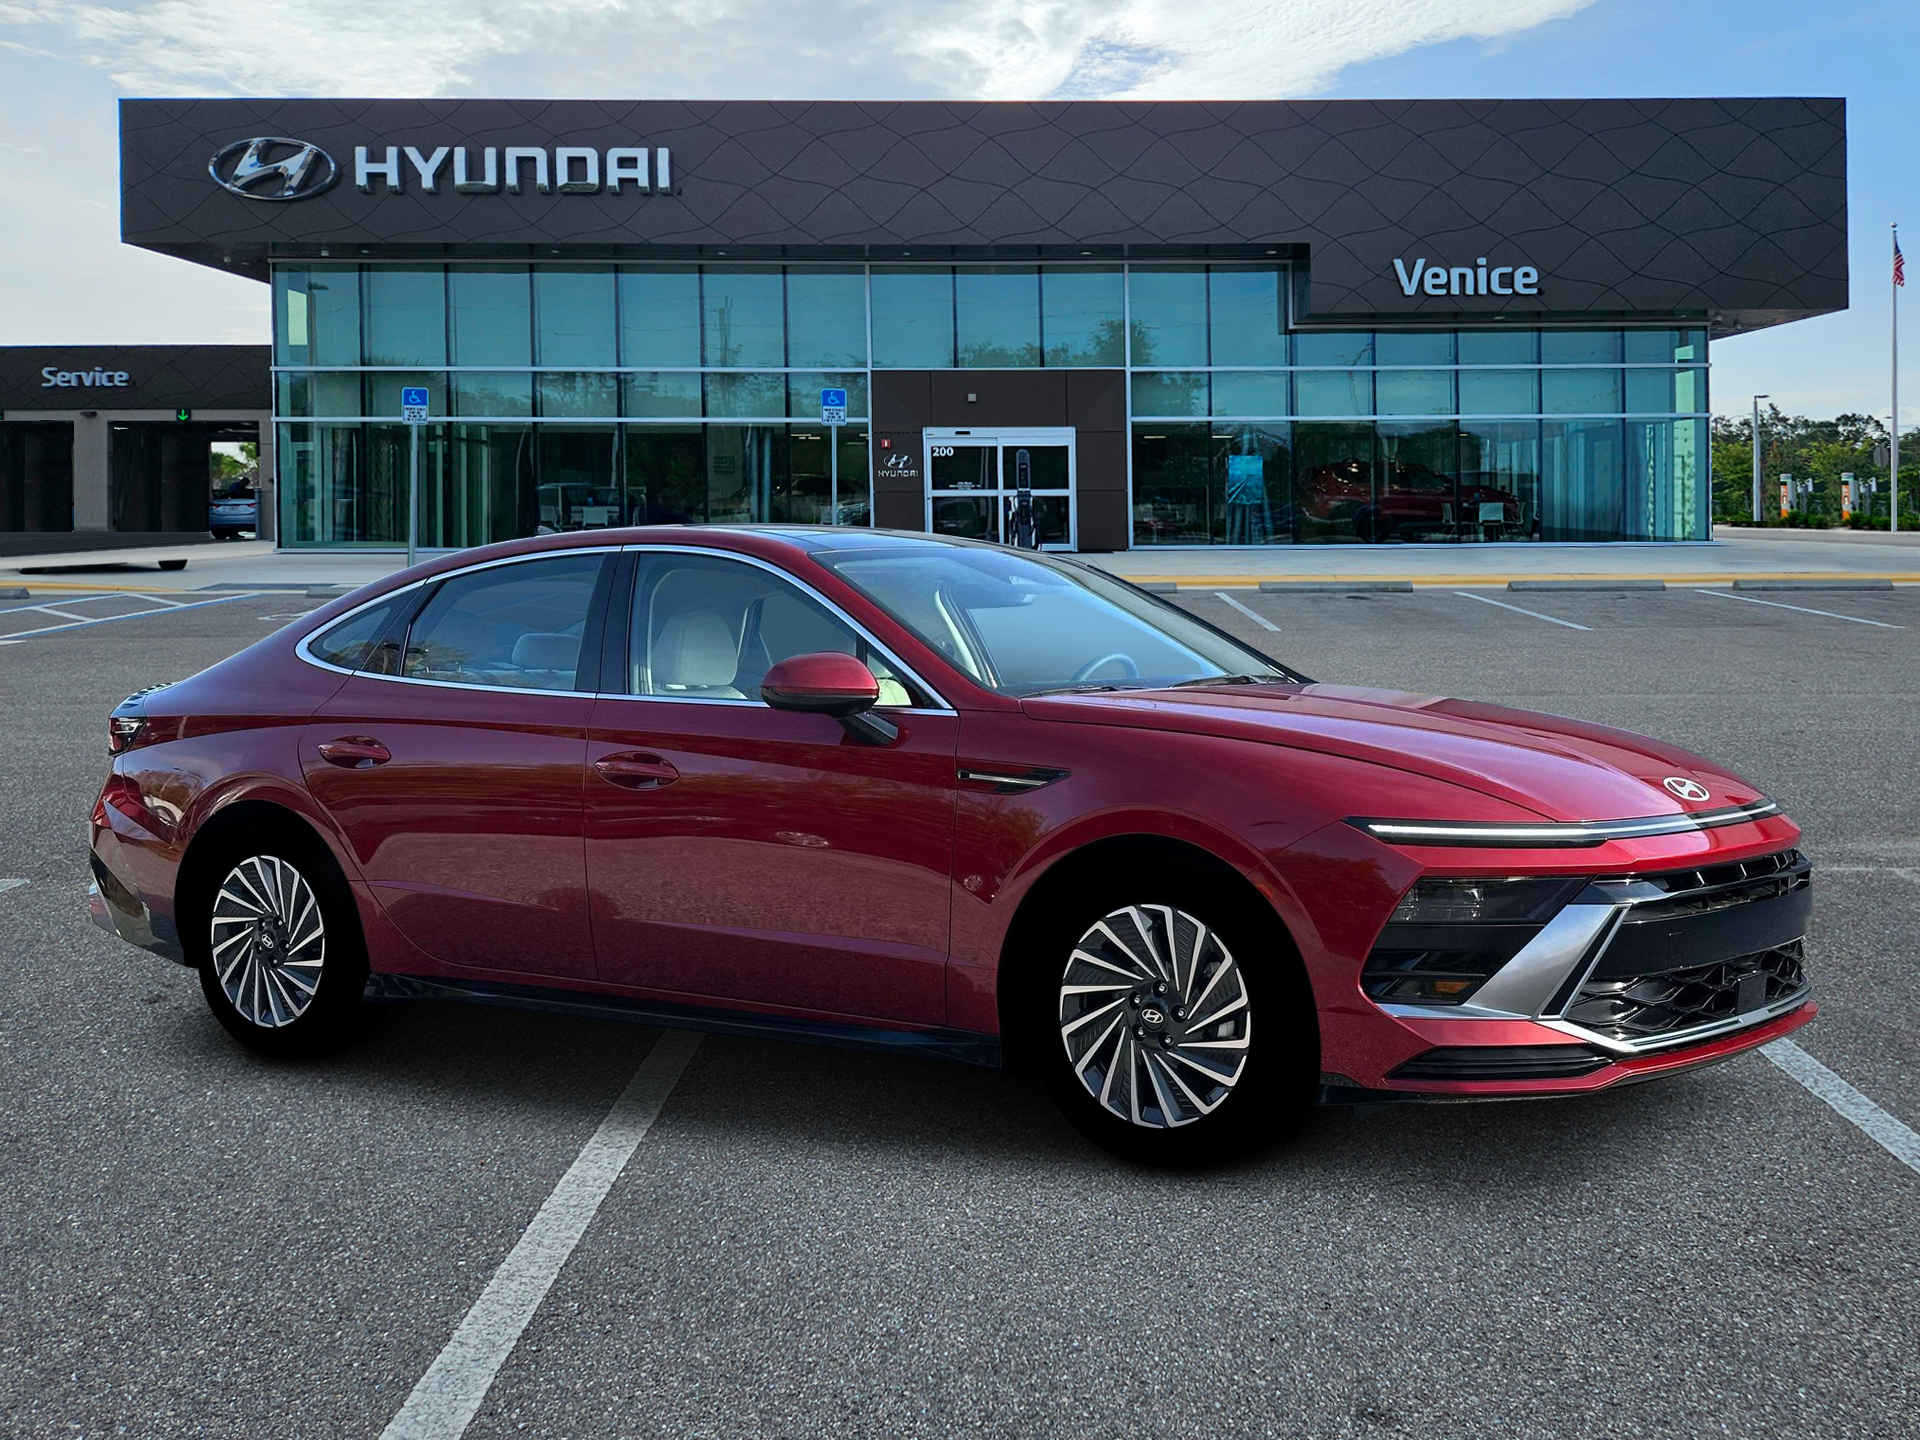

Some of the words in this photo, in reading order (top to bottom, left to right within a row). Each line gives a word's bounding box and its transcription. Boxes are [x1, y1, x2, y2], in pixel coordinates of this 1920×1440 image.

[354, 145, 674, 195] HYUNDAI
[1393, 257, 1540, 297] Venice
[41, 366, 131, 388] Service
[932, 447, 954, 457] 200
[877, 470, 919, 478] HYUNDAI
